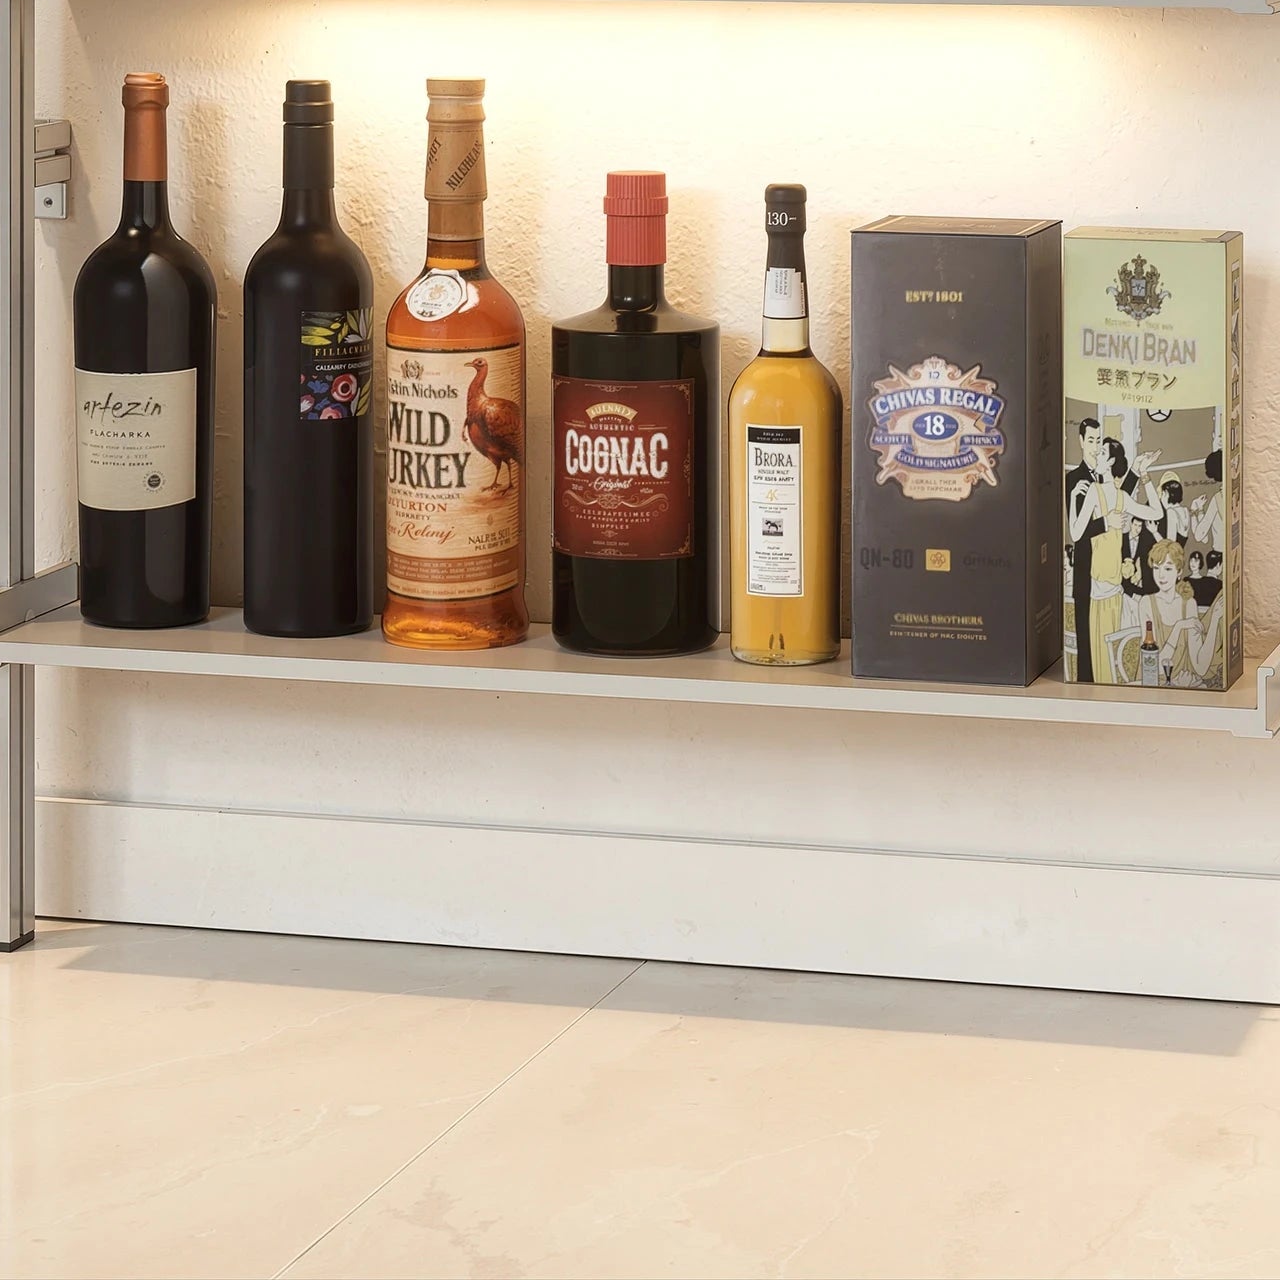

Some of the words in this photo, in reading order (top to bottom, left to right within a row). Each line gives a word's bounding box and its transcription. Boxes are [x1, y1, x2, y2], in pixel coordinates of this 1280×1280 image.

[1082, 328, 1139, 365] DENKI
[1143, 332, 1197, 367] BRAN
[411, 383, 458, 399] Nichols
[875, 387, 935, 414] CHIVAS
[939, 387, 996, 416] REGAL
[389, 400, 450, 447] WILD
[923, 415, 945, 436] 18
[566, 429, 669, 479] COGNAC
[754, 446, 794, 467] BRORA
[893, 612, 929, 624] CHIVAS
